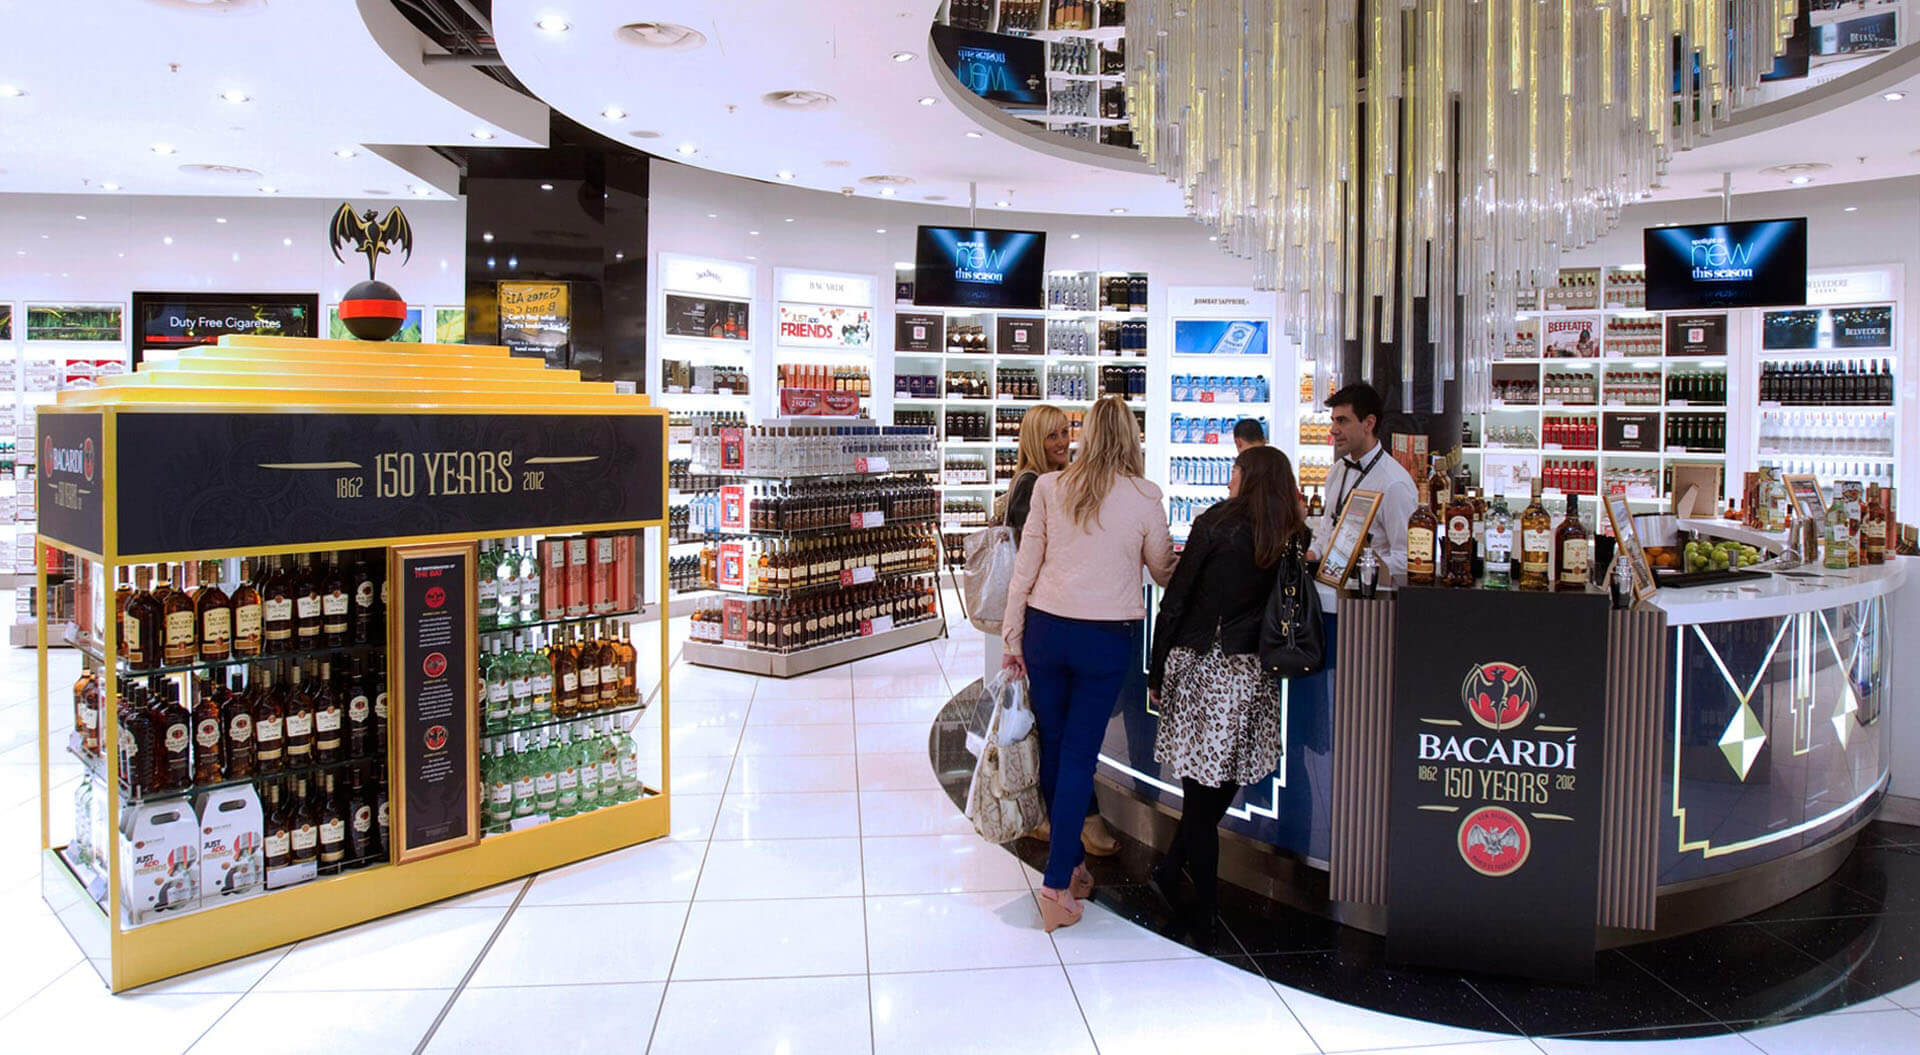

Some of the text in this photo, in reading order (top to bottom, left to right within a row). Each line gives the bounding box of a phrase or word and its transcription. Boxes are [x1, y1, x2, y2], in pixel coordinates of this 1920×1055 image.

[956, 246, 1007, 269] new
[1691, 242, 1755, 267] new
[955, 267, 1003, 281] this season
[1692, 267, 1753, 279] this season
[170, 316, 282, 330] Duty Free Cigarettes
[780, 321, 833, 339] FRIENDS
[1548, 321, 1593, 334] BEEFEATER
[52, 443, 84, 475] BACARDÍ
[336, 449, 545, 499] 1862 150 YEARS 2012
[1417, 733, 1577, 770] BACARDÍ
[1418, 765, 1576, 805] 1862 150 YEARS 2012
[204, 839, 221, 850] JUST
[136, 854, 154, 865] JUST
